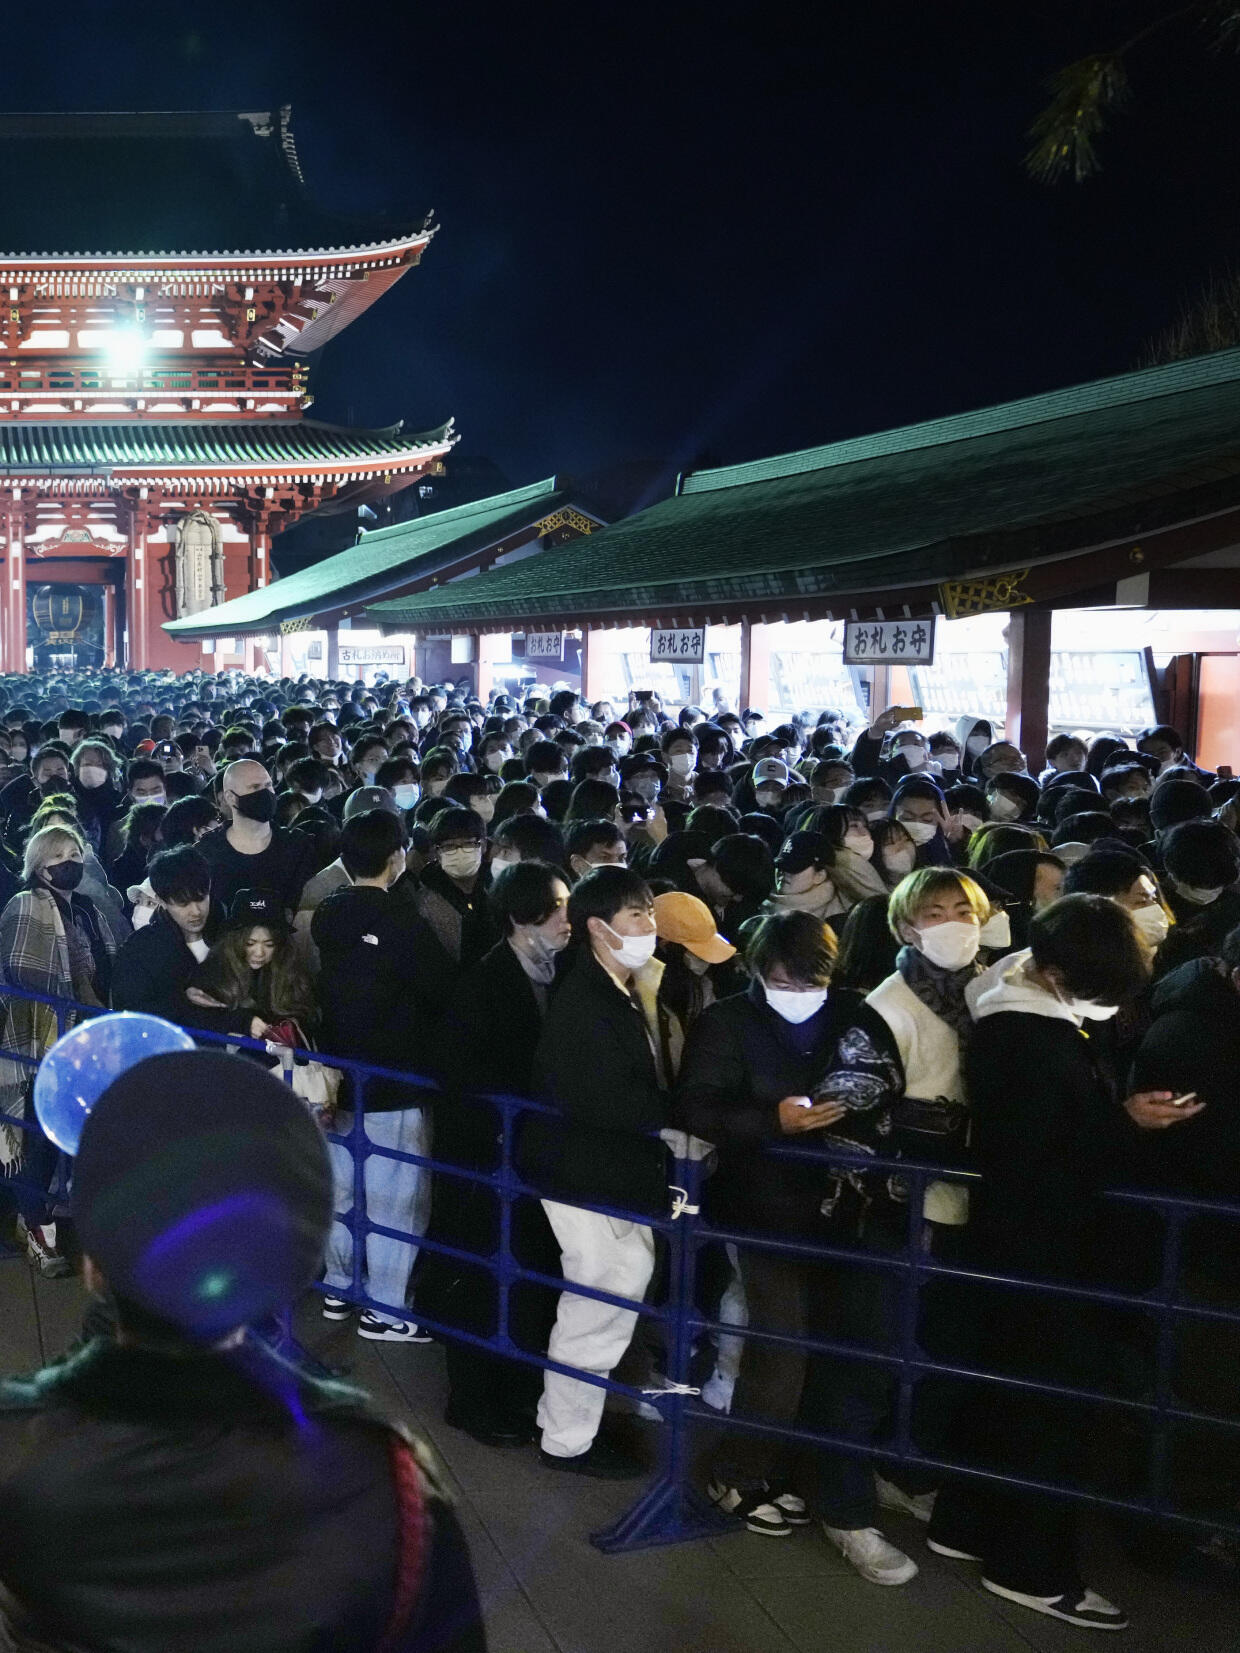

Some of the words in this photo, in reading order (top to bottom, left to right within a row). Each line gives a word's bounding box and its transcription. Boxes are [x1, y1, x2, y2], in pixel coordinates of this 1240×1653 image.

[657, 631, 701, 656] お札お守
[854, 623, 927, 656] お札お守
